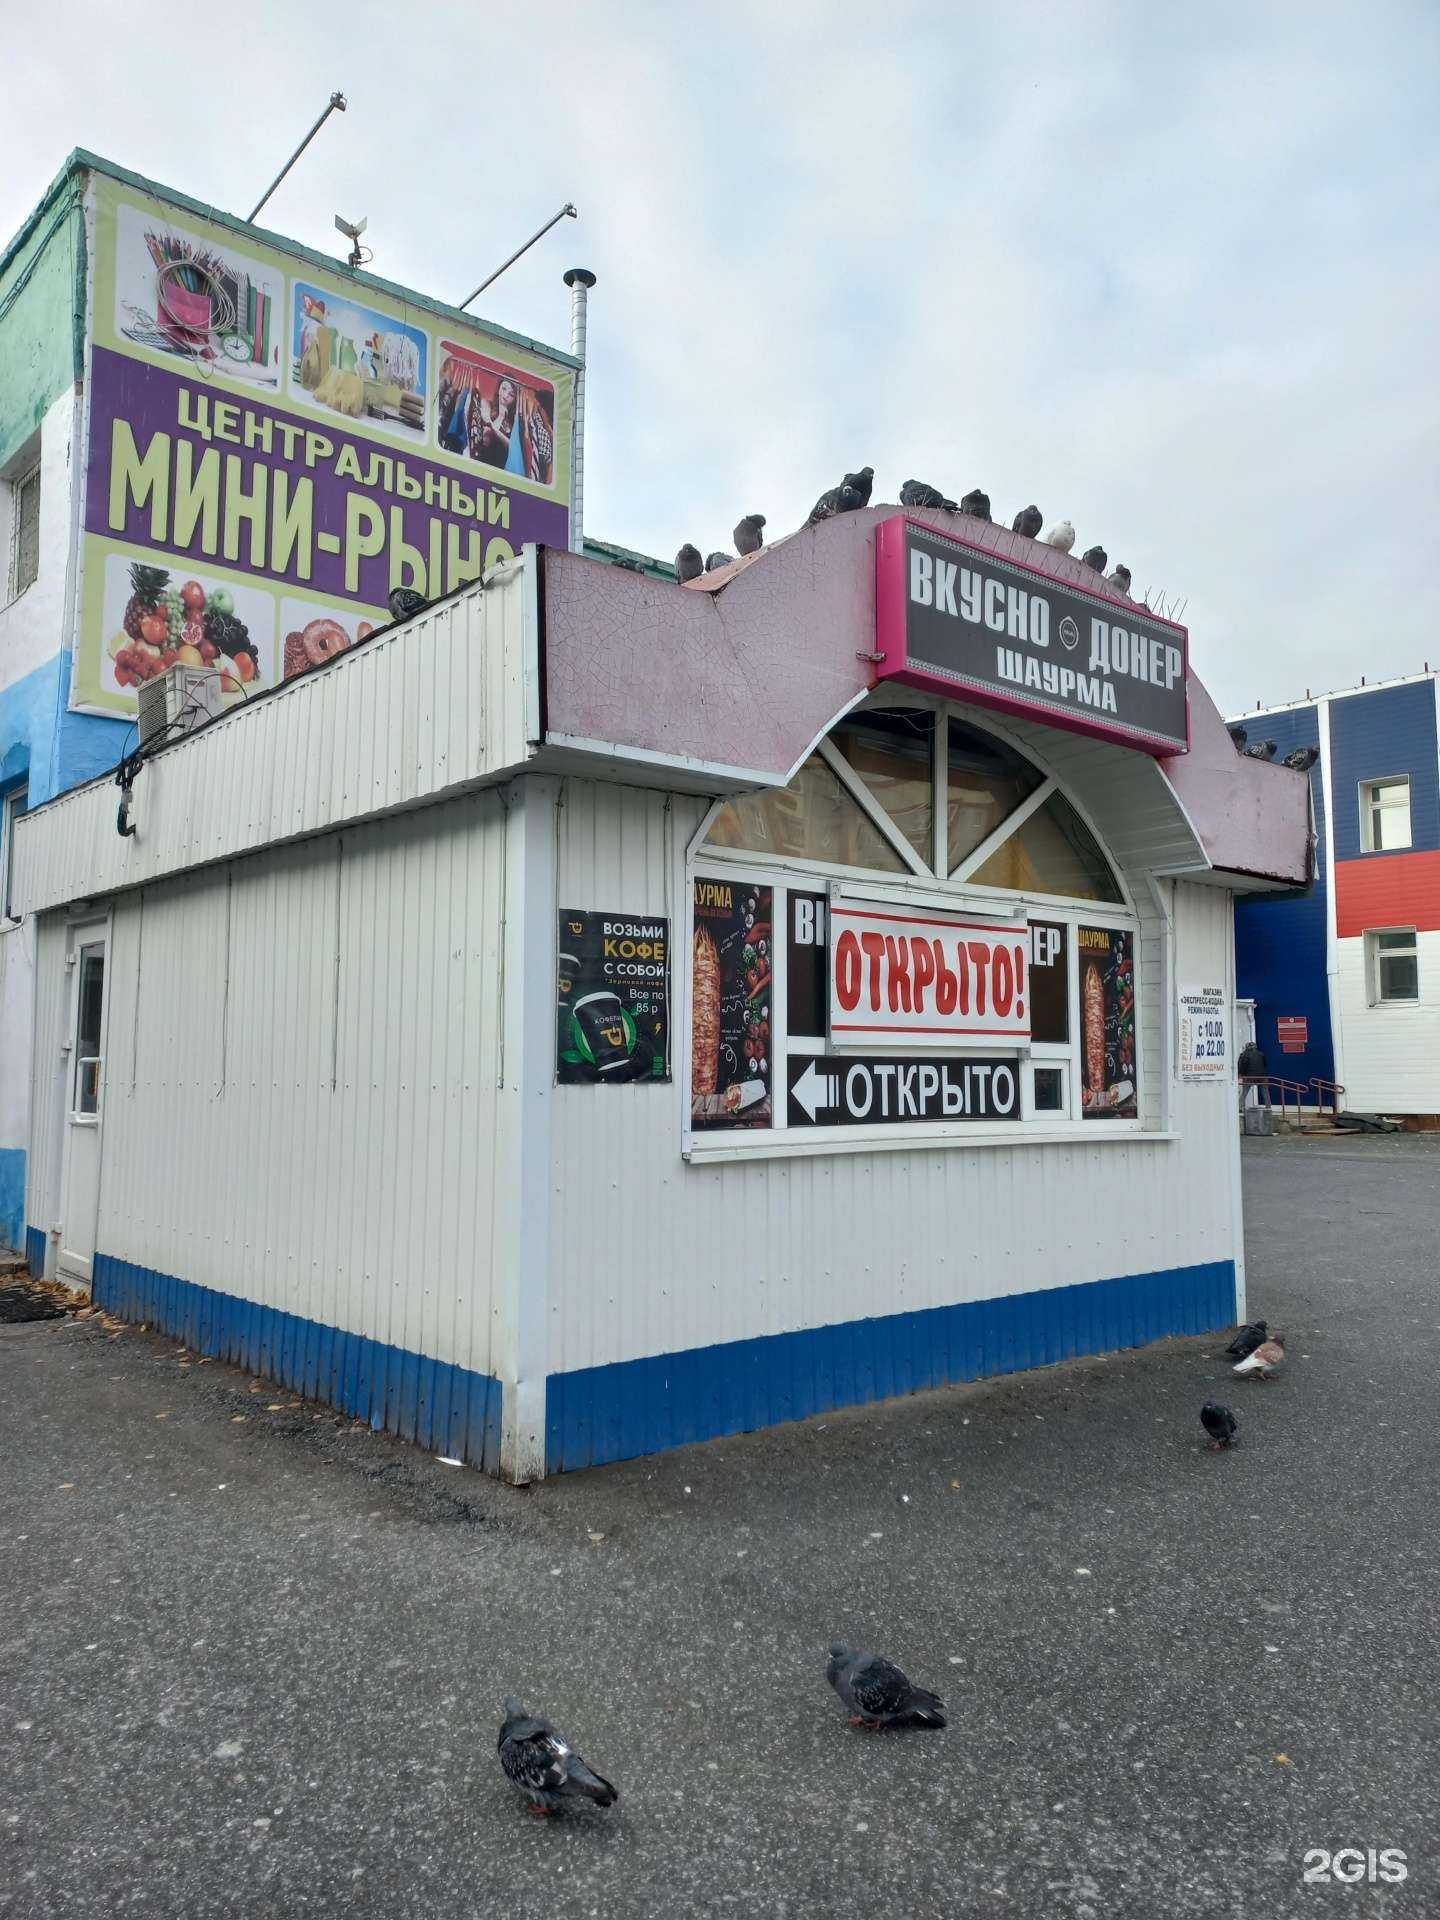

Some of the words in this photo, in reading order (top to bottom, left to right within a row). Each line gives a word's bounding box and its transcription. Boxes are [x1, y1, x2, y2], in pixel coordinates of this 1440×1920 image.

[177, 388, 511, 530] ЦЕНТРАЛЬНЫЙ
[910, 548, 1051, 648] ВКУСНО
[1088, 617, 1182, 690] ДОНЕР
[996, 646, 1118, 713] ШАУРМА
[603, 922, 664, 939] ВОЗЬМИ
[1078, 930, 1110, 950] ШАУРМА
[605, 938, 664, 960] КОФЕ
[603, 963, 614, 974] С
[616, 963, 665, 977] СОБОЙ
[835, 929, 1025, 1019] ОТКРЫТО!
[629, 988, 649, 999] Все
[651, 991, 664, 1000] по
[636, 1002, 649, 1013] 85
[1204, 1021, 1223, 1037] 10.00
[1196, 1043, 1205, 1059] до
[1206, 1040, 1225, 1056] 22.00
[845, 1063, 1015, 1118] ОТКРЫТО
